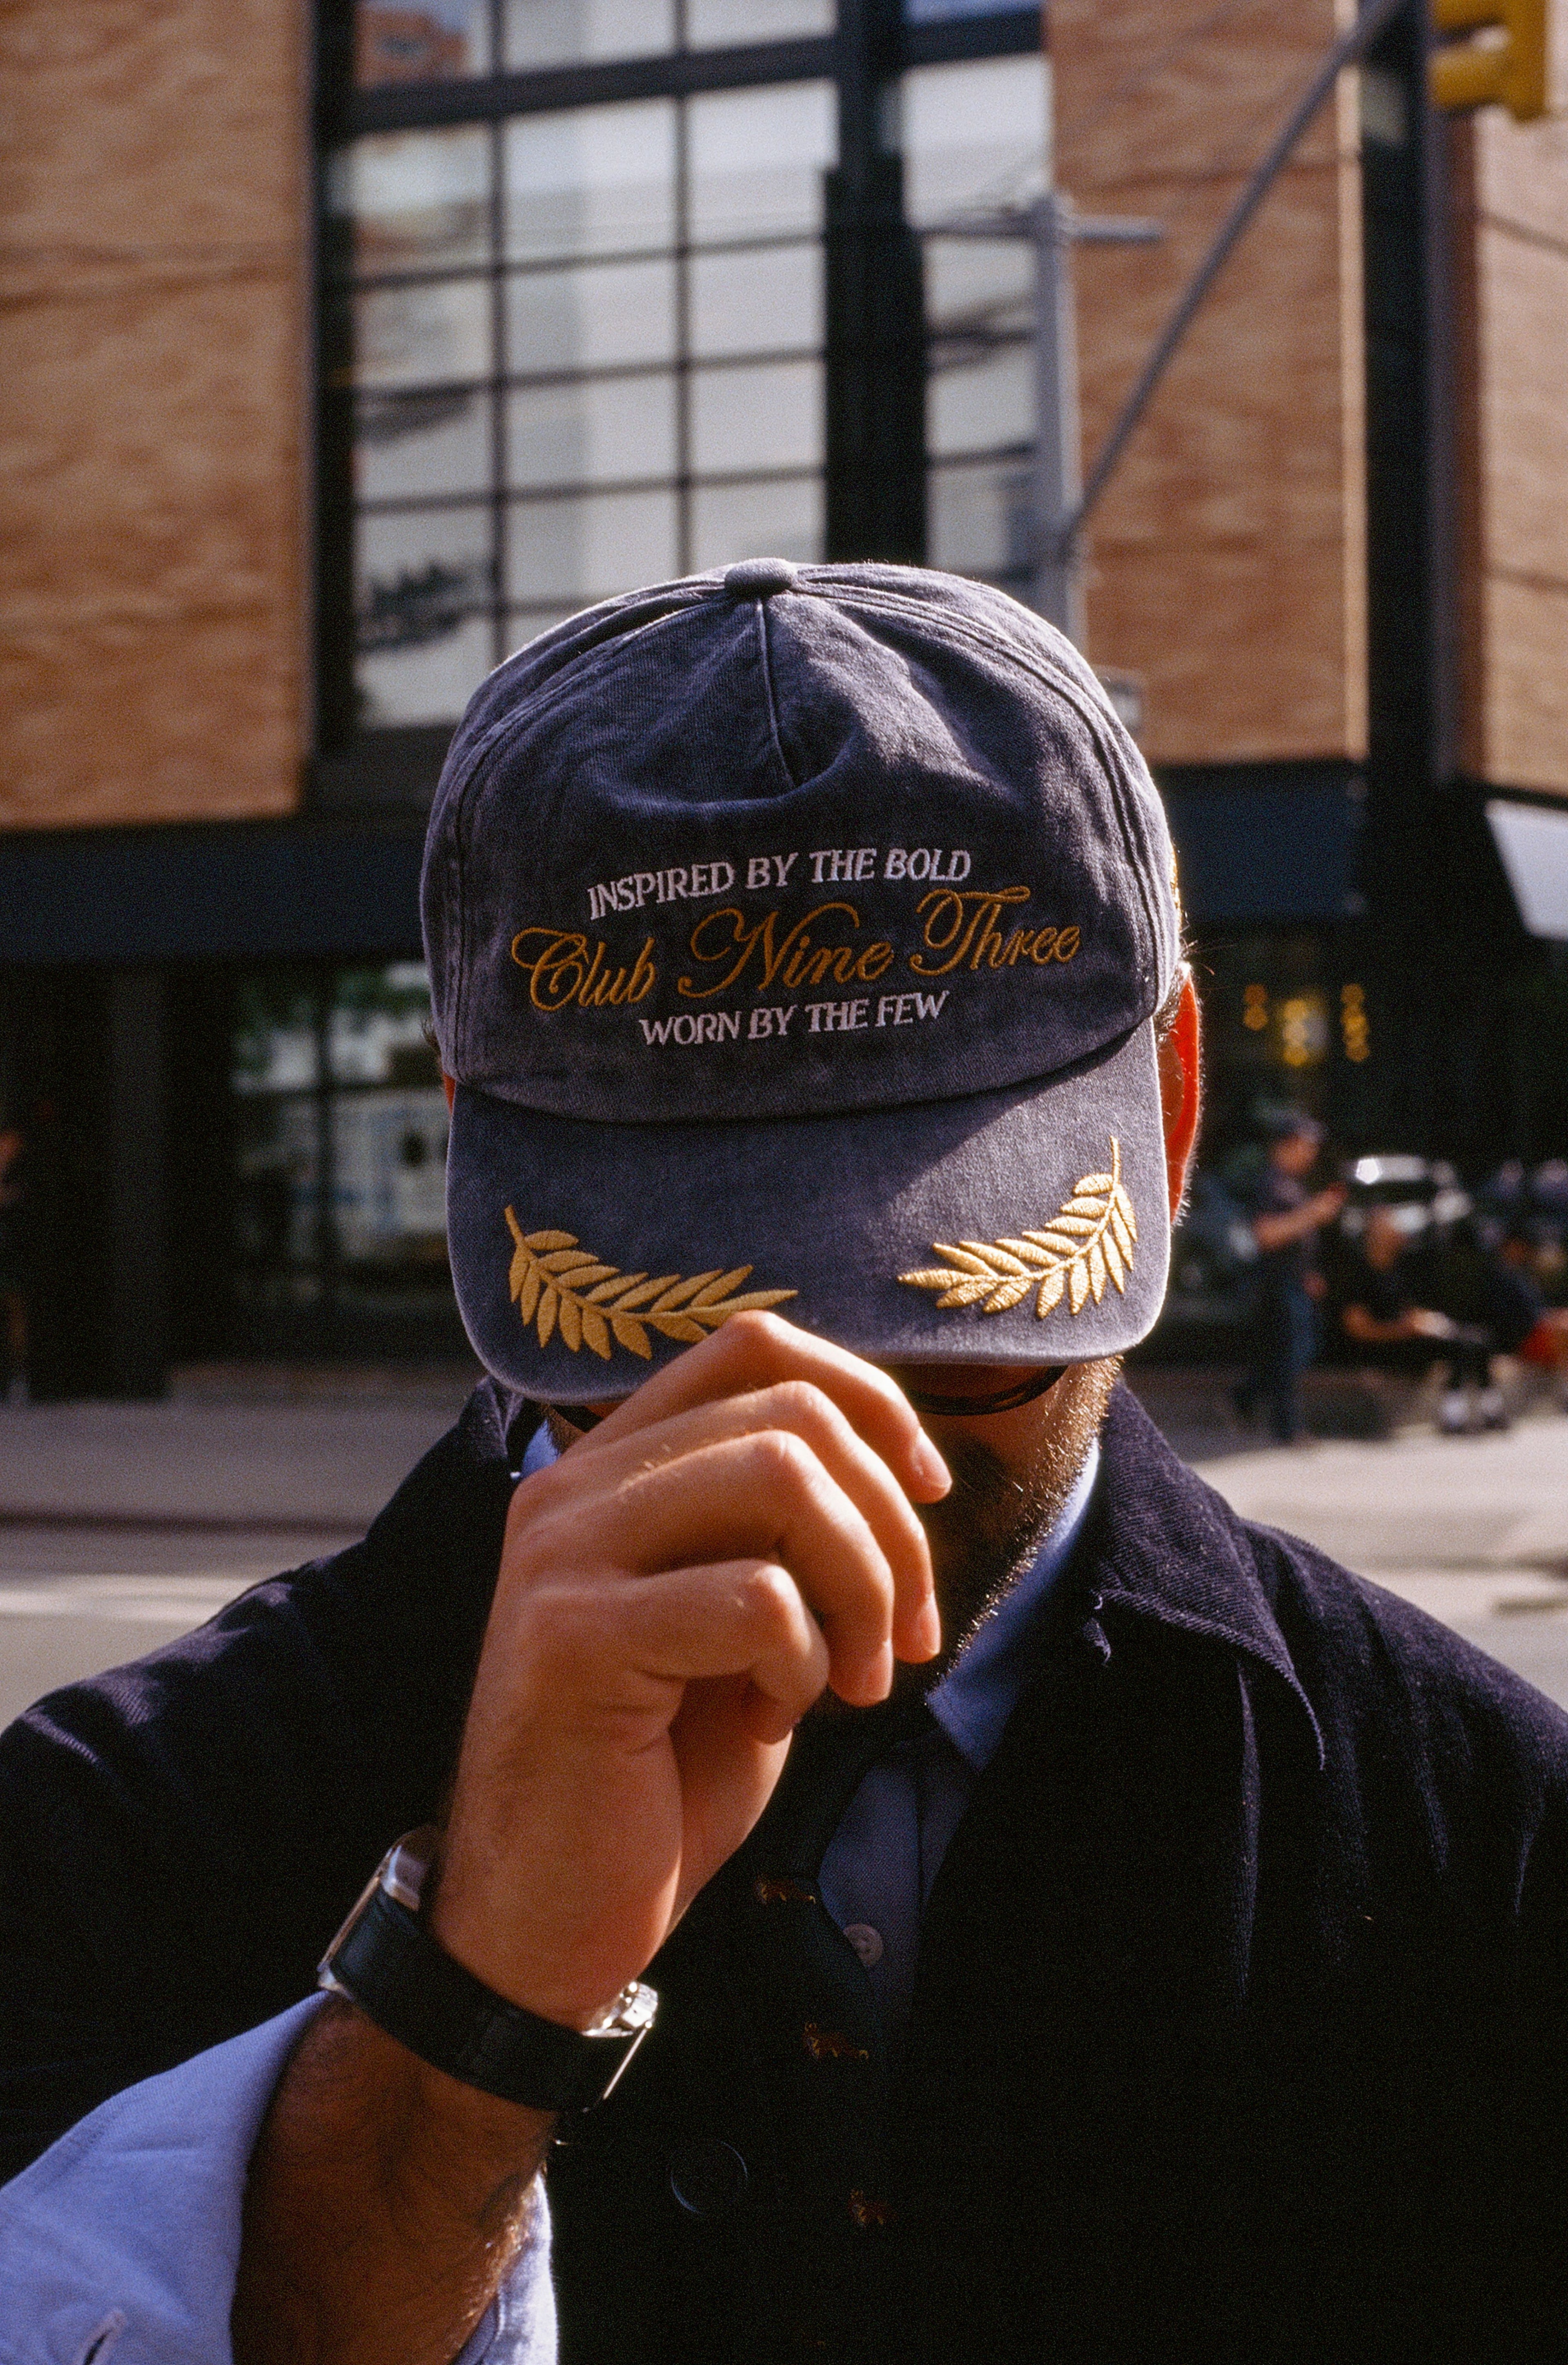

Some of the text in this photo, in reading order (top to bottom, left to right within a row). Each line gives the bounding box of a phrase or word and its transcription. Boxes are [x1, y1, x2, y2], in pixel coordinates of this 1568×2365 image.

[588, 849, 971, 920] INSPIRED BY THE BOLD
[512, 886, 1080, 1011] Club Nine Three
[639, 990, 949, 1045] WORN BY THE FEW
